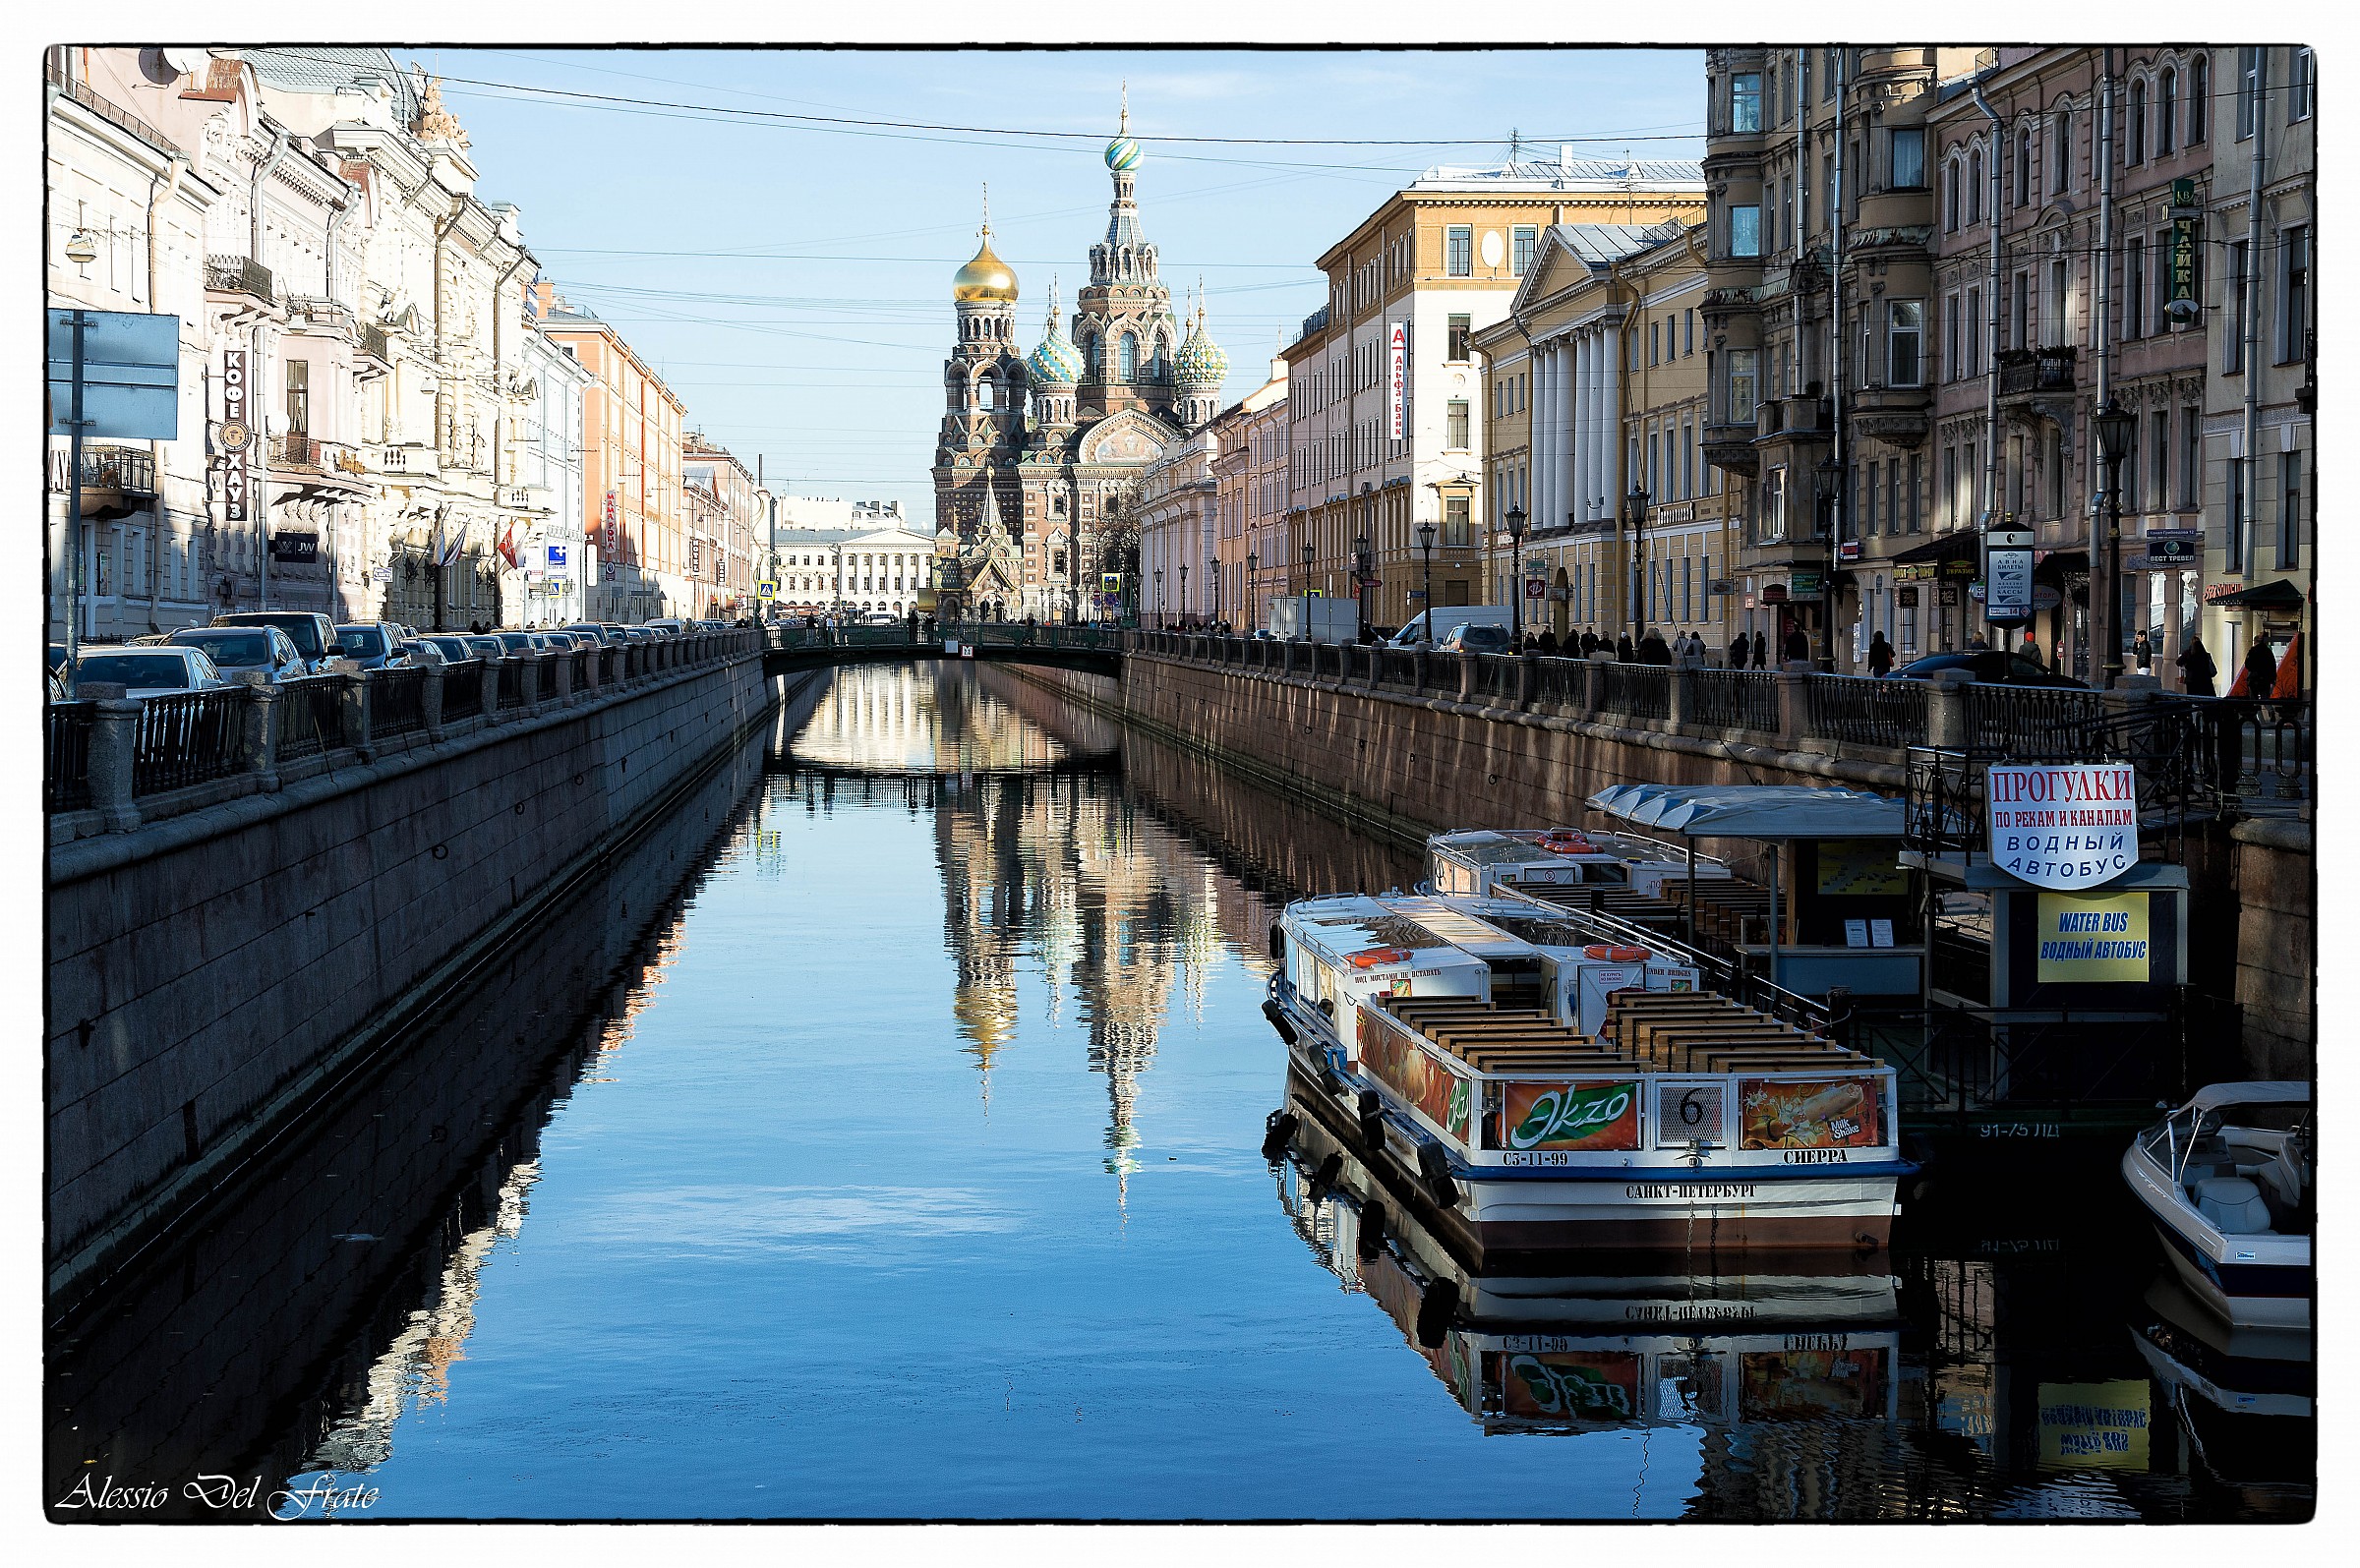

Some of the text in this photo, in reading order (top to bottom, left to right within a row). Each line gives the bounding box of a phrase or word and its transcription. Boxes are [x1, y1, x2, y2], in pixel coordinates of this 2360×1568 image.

[2176, 220, 2192, 299] ЧАЙКА
[225, 353, 243, 418] КОФЕ
[227, 454, 244, 519] ХАУЗ
[298, 542, 315, 552] JW
[1992, 770, 2133, 802] ПРОГУЛКИ
[1995, 809, 2133, 828] ПО РЕКАМ И КАНАЛАМ
[2007, 832, 2124, 854] ВОДНЫЙ
[2007, 854, 2126, 877] АВТОБУС
[2058, 910, 2129, 932] WATER BUS
[2040, 937, 2147, 962] ВОДНЫЙ АВТОБУС
[1370, 973, 1397, 982] МОСТАМИ
[1411, 968, 1442, 978] ВСТАВАТЬ
[1646, 967, 1691, 977] UNDER BRIDGES
[1681, 1087, 1704, 1126] 6
[1830, 1118, 1850, 1131] Milk
[1834, 1124, 1860, 1139] Shake
[1783, 1149, 1849, 1164] СИЕРРА
[1625, 1185, 1757, 1199] САНКТ-ПЕТЕРБУРГ
